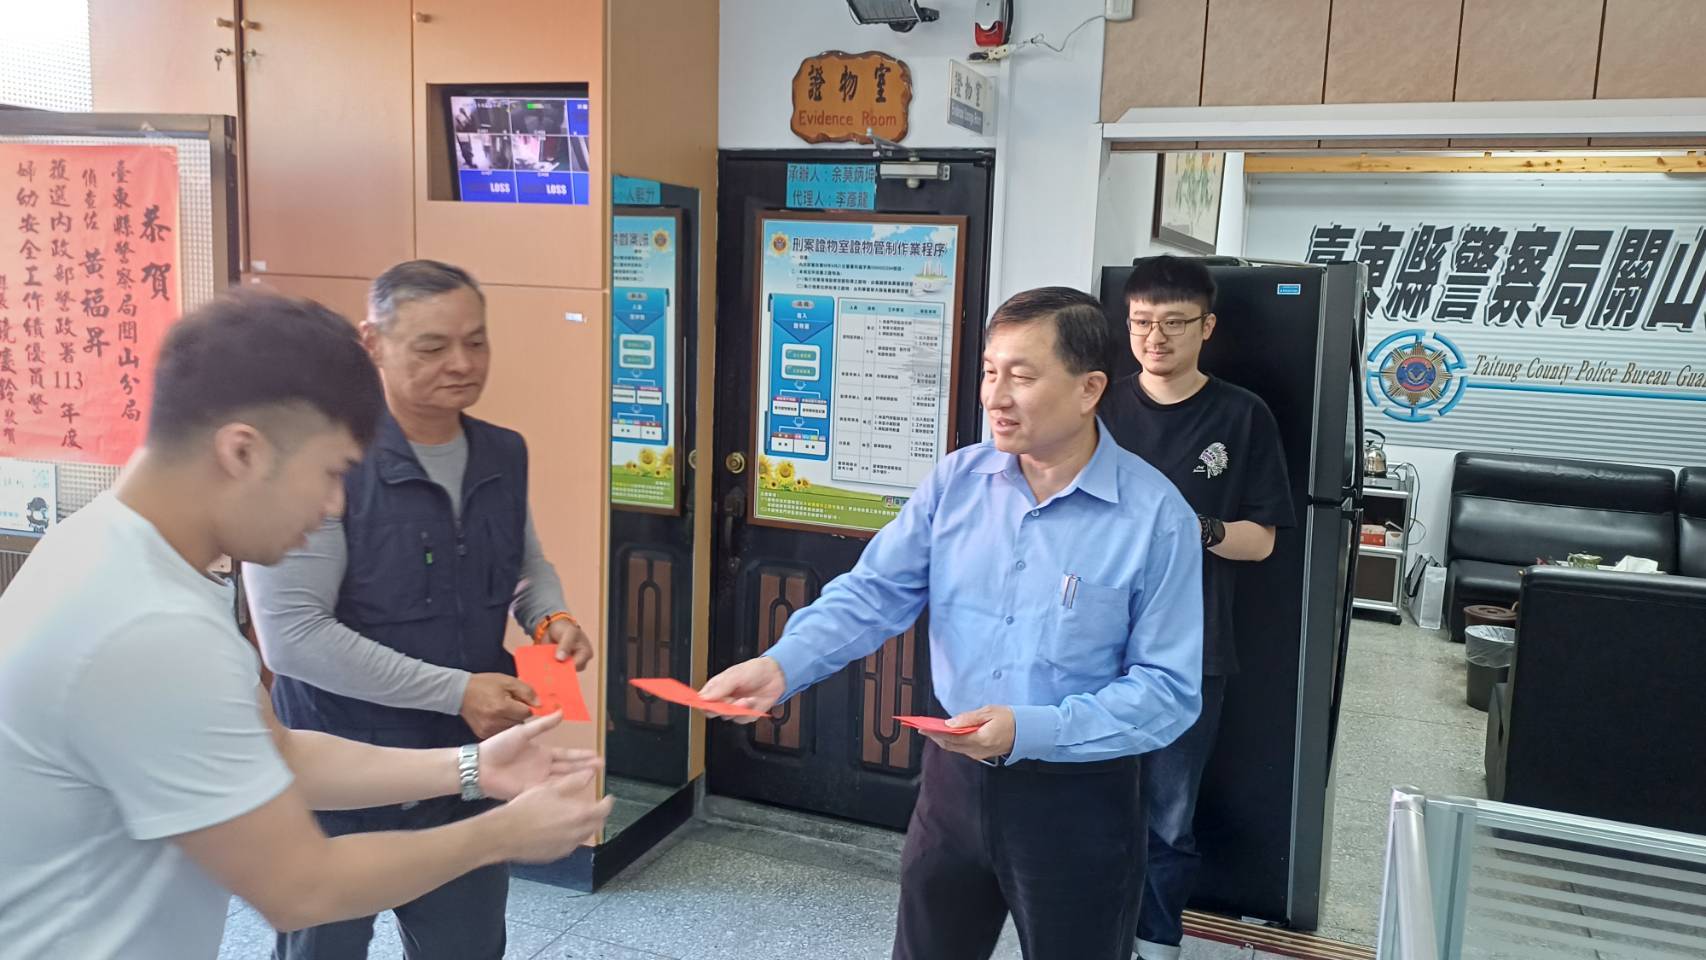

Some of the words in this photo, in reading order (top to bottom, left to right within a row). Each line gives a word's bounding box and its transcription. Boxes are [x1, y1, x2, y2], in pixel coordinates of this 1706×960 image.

[807, 63, 891, 103] 證物室
[799, 110, 853, 126] Evidence
[862, 111, 897, 127] Room
[139, 204, 172, 301] 恭賀
[792, 237, 946, 257] 刑案證物室證物管制作業程序
[1472, 354, 1523, 382] Taitung
[1527, 357, 1573, 385] County
[1575, 360, 1618, 383] Police
[1621, 362, 1671, 387] Bureau
